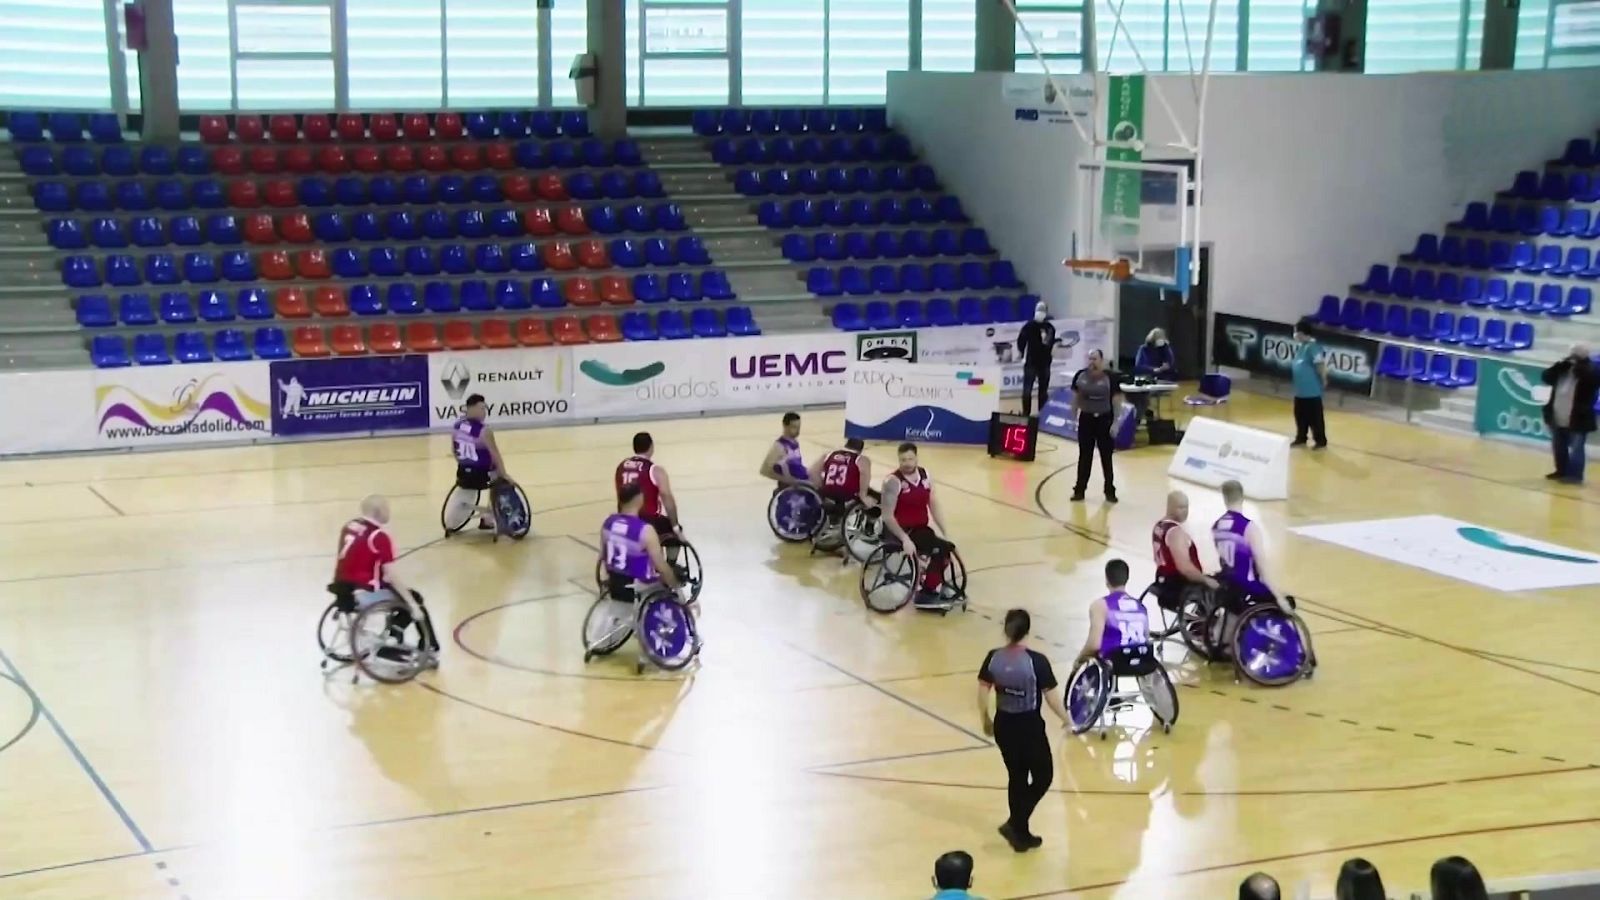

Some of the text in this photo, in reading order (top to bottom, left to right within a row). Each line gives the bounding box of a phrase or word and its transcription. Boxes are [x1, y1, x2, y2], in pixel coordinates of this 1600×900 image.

[730, 351, 847, 379] UEMC
[477, 370, 544, 382] RENAULT
[732, 379, 846, 392] UNIVERSIDAD
[308, 387, 416, 406] MICHELIN
[636, 377, 719, 401] aliados
[436, 405, 469, 419] VAS
[498, 400, 568, 416] ARROYO
[106, 419, 265, 439] www.bsrvalladolid.com
[1004, 428, 1027, 452] 15
[825, 464, 848, 486] 23
[339, 534, 355, 560] 7
